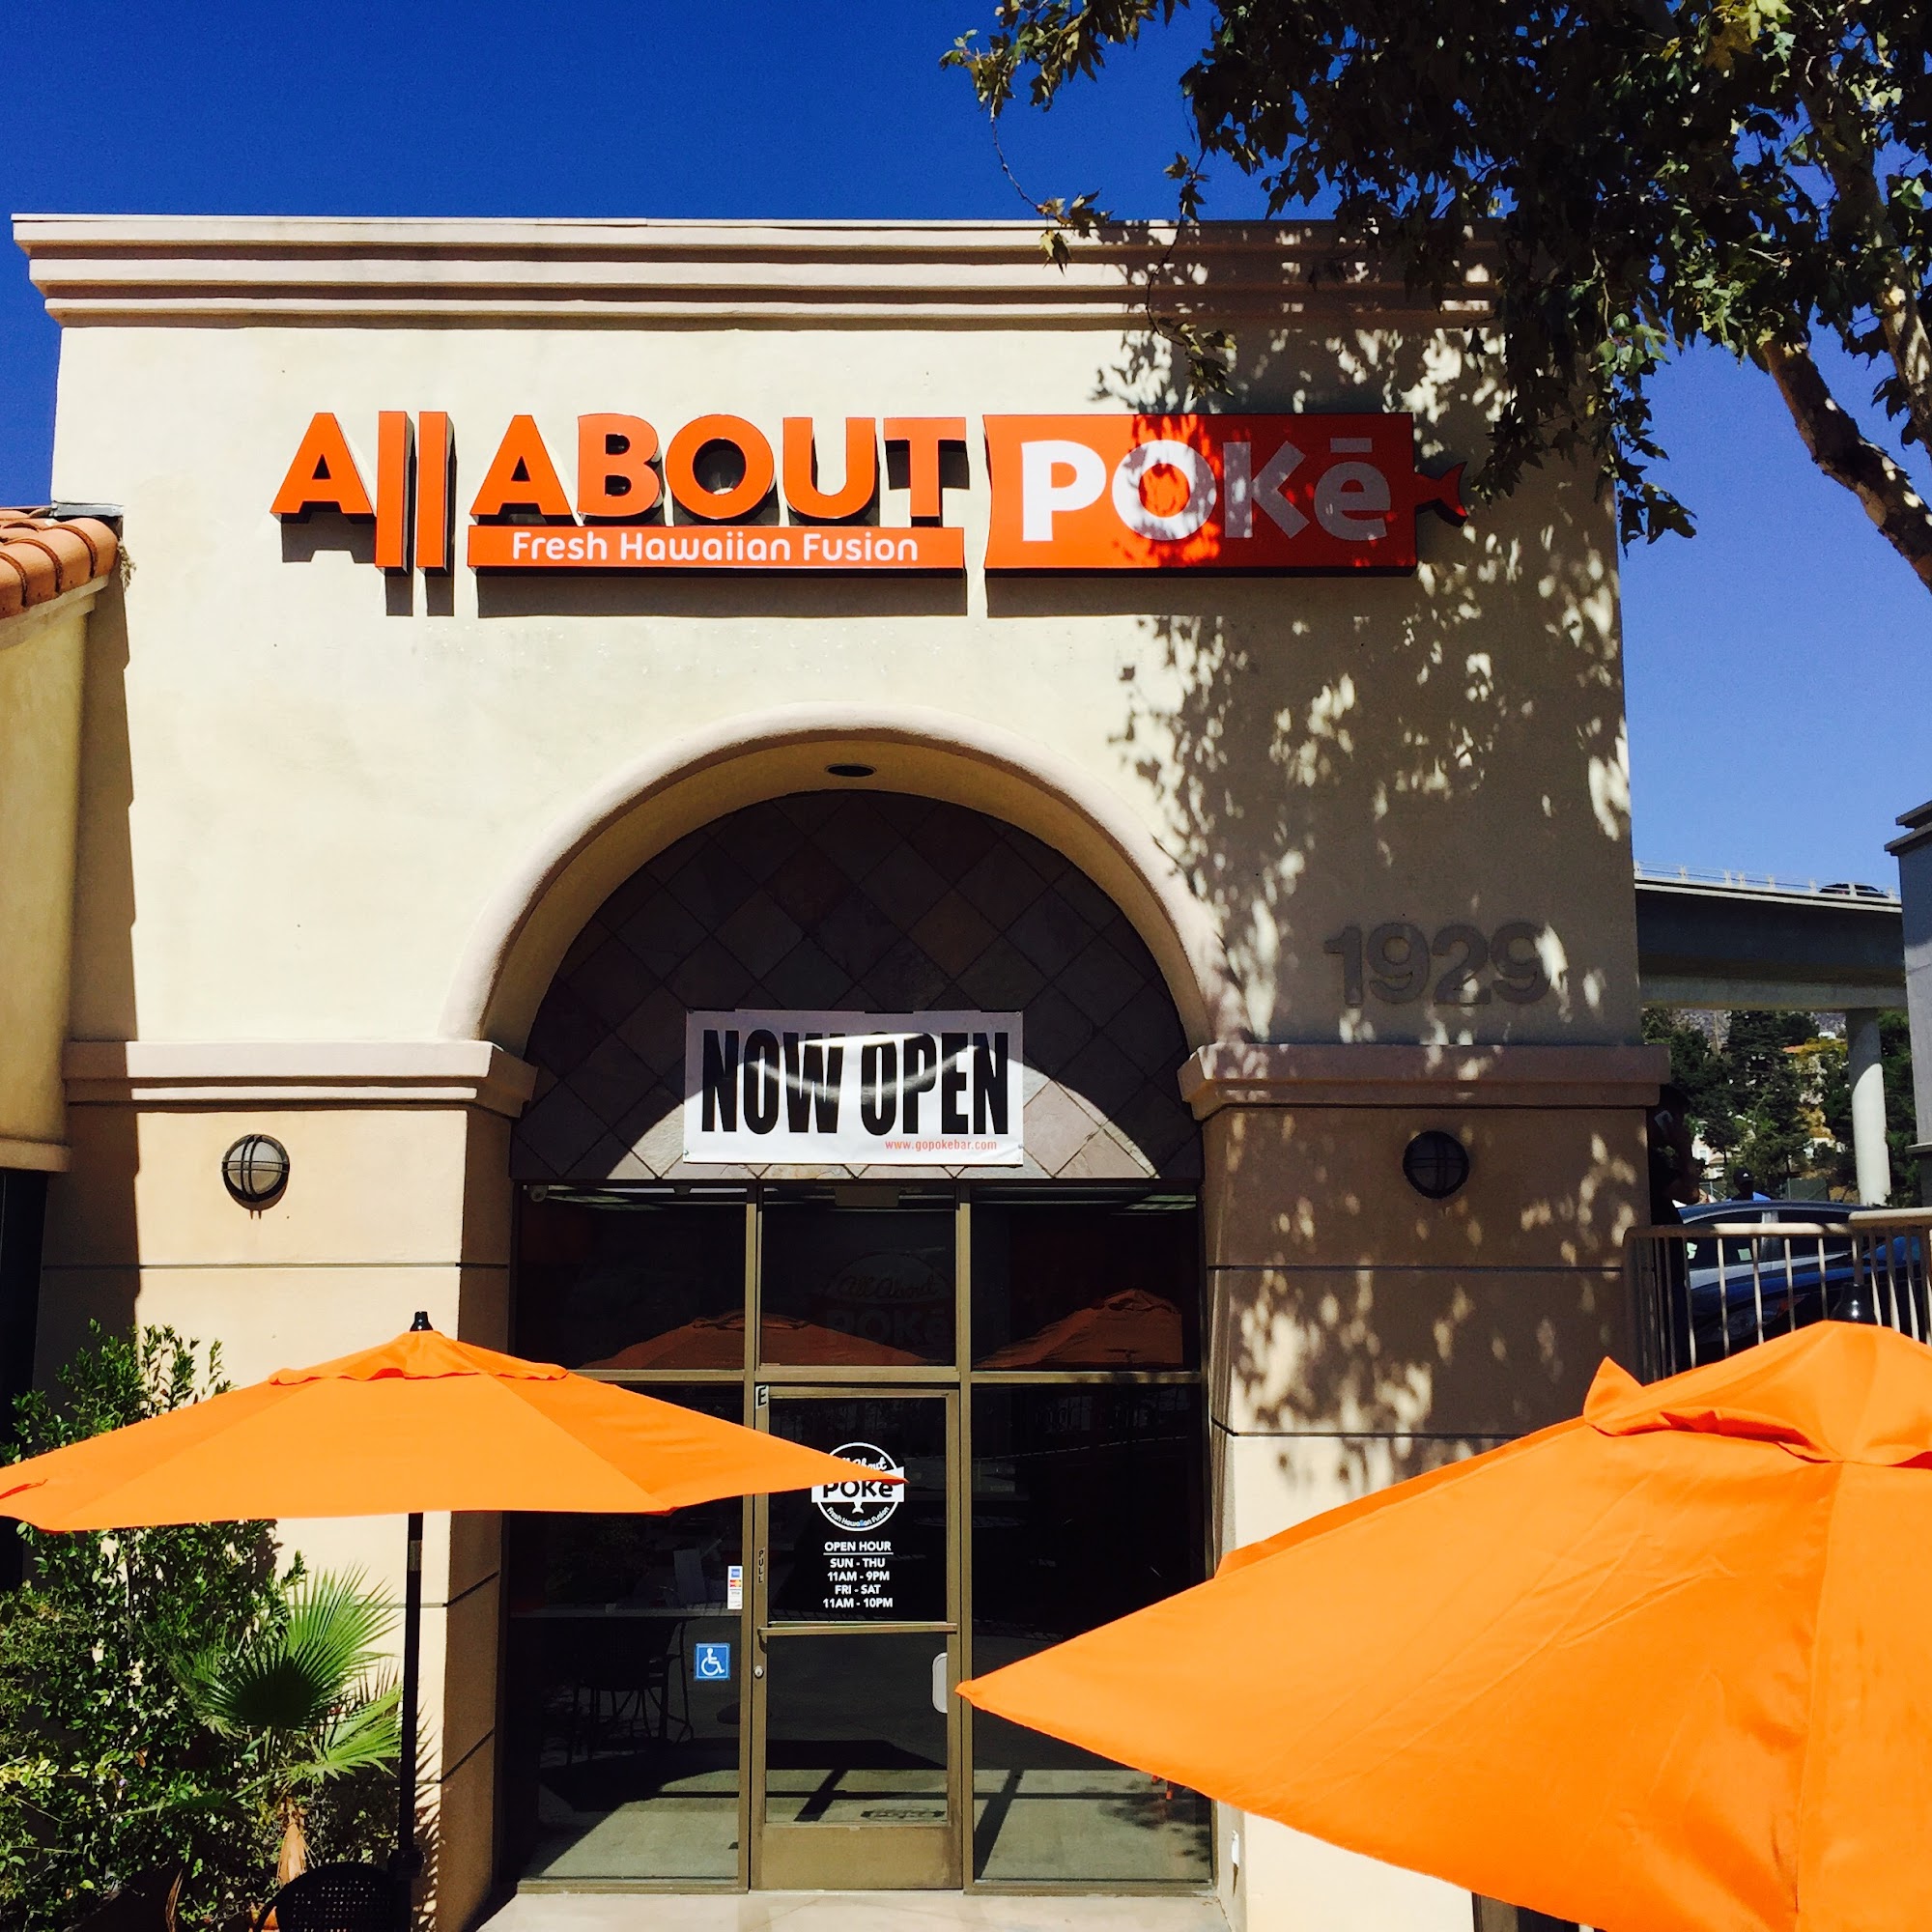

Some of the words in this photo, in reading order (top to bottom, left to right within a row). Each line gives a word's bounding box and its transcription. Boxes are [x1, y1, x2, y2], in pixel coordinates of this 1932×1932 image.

[470, 413, 966, 519] ABOUT
[513, 531, 608, 561] Fresh
[620, 531, 791, 562] Hawaiian
[804, 531, 919, 562] Fusion
[1323, 921, 1551, 1005] 1929
[701, 1029, 846, 1134] NOW
[861, 1031, 1009, 1135] OPEN
[885, 1139, 997, 1151] www.gopokebar.com
[758, 1385, 767, 1406] E
[824, 1541, 856, 1551] OPEN
[859, 1541, 892, 1551] HOUR
[830, 1557, 854, 1568] SUN
[862, 1557, 886, 1568] THU
[827, 1571, 858, 1581] 11AM
[866, 1571, 890, 1581] 9PM
[835, 1584, 852, 1595] FRI
[861, 1584, 881, 1595] SAT
[823, 1598, 854, 1608] 11AM
[864, 1598, 894, 1608] 10PM
